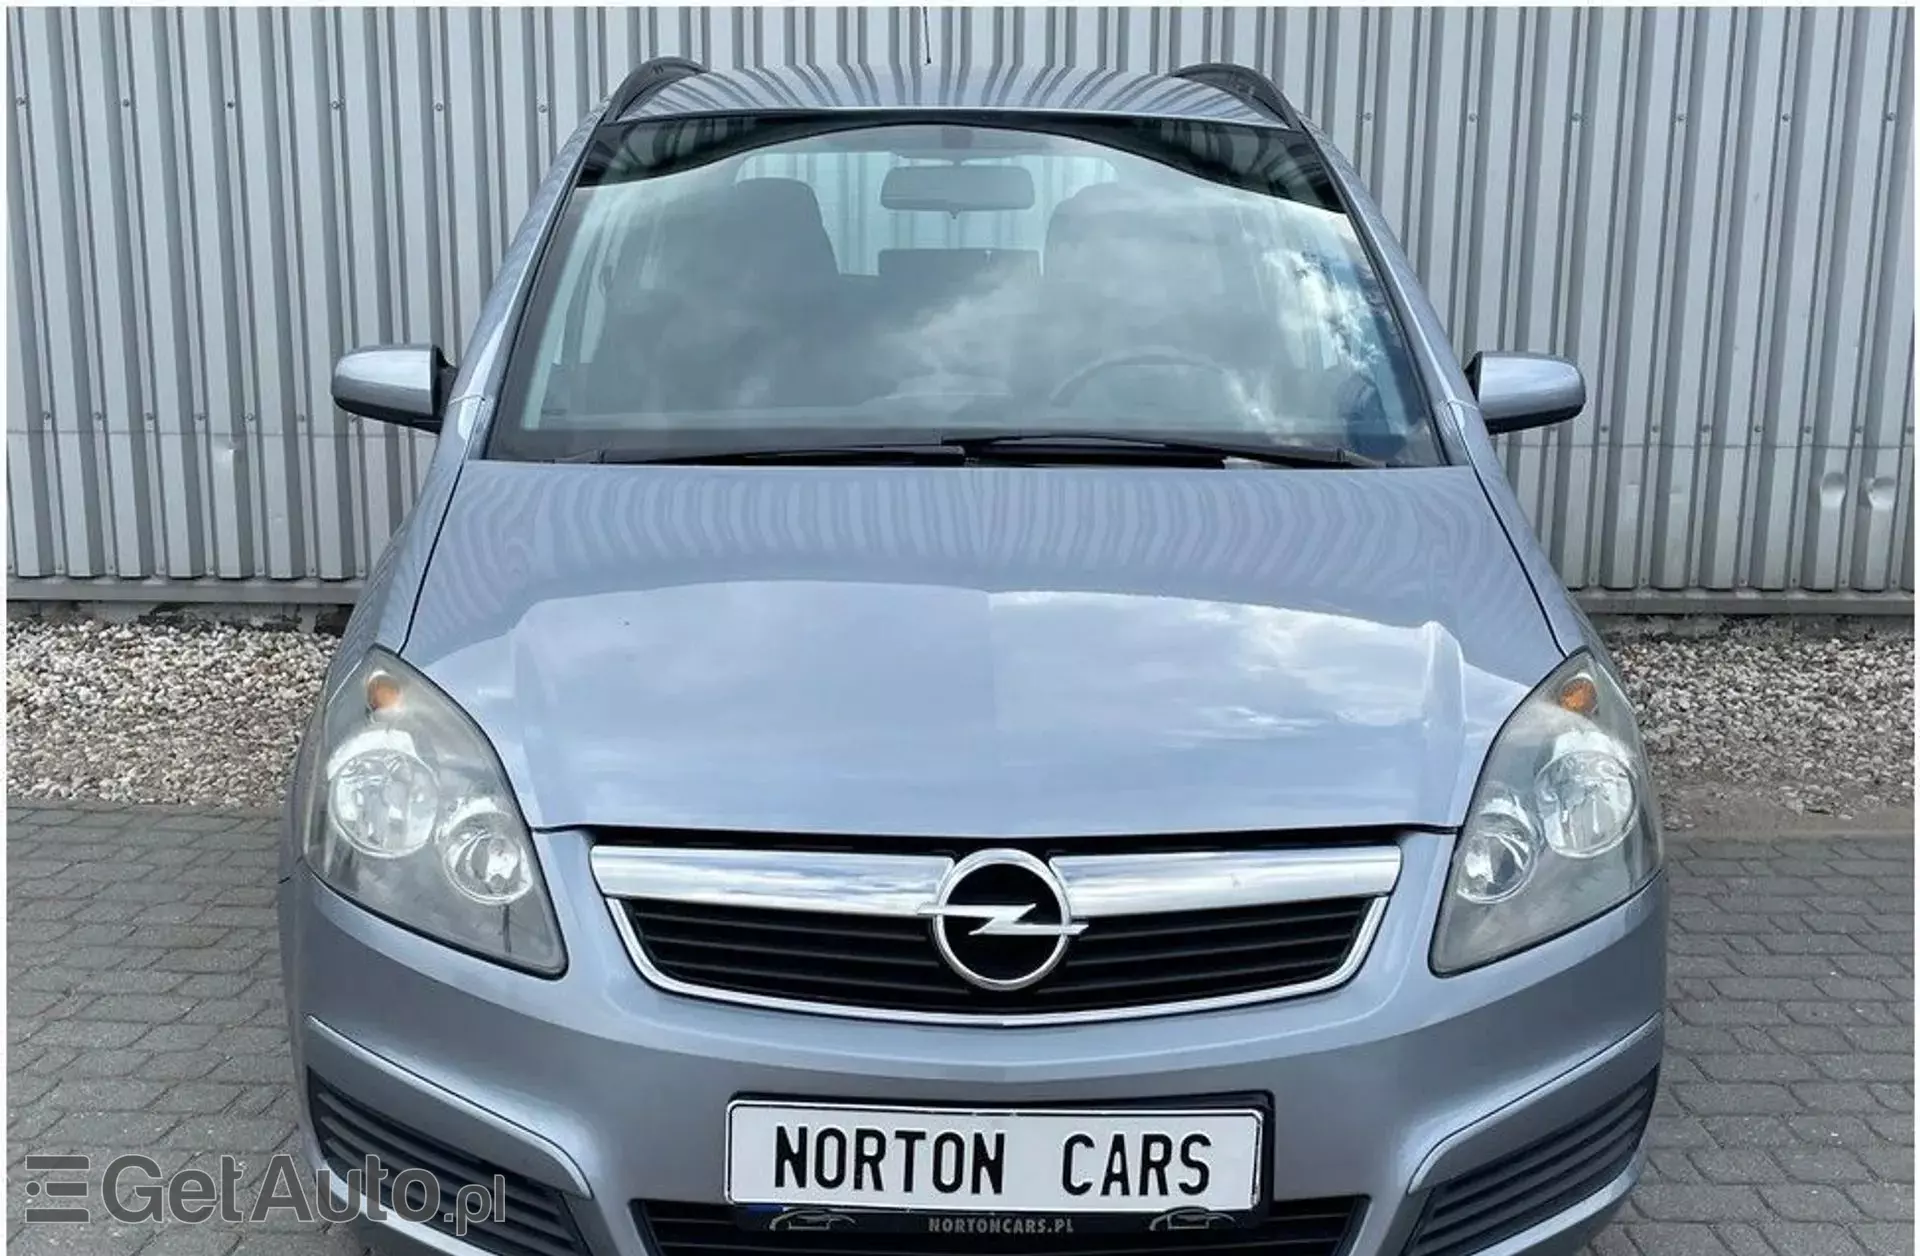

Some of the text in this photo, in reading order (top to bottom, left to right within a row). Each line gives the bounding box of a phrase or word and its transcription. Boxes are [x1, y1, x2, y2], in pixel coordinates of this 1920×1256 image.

[774, 1125, 1211, 1196] NORTON CARS
[928, 1217, 1074, 1234] NORTONCARS.PL
